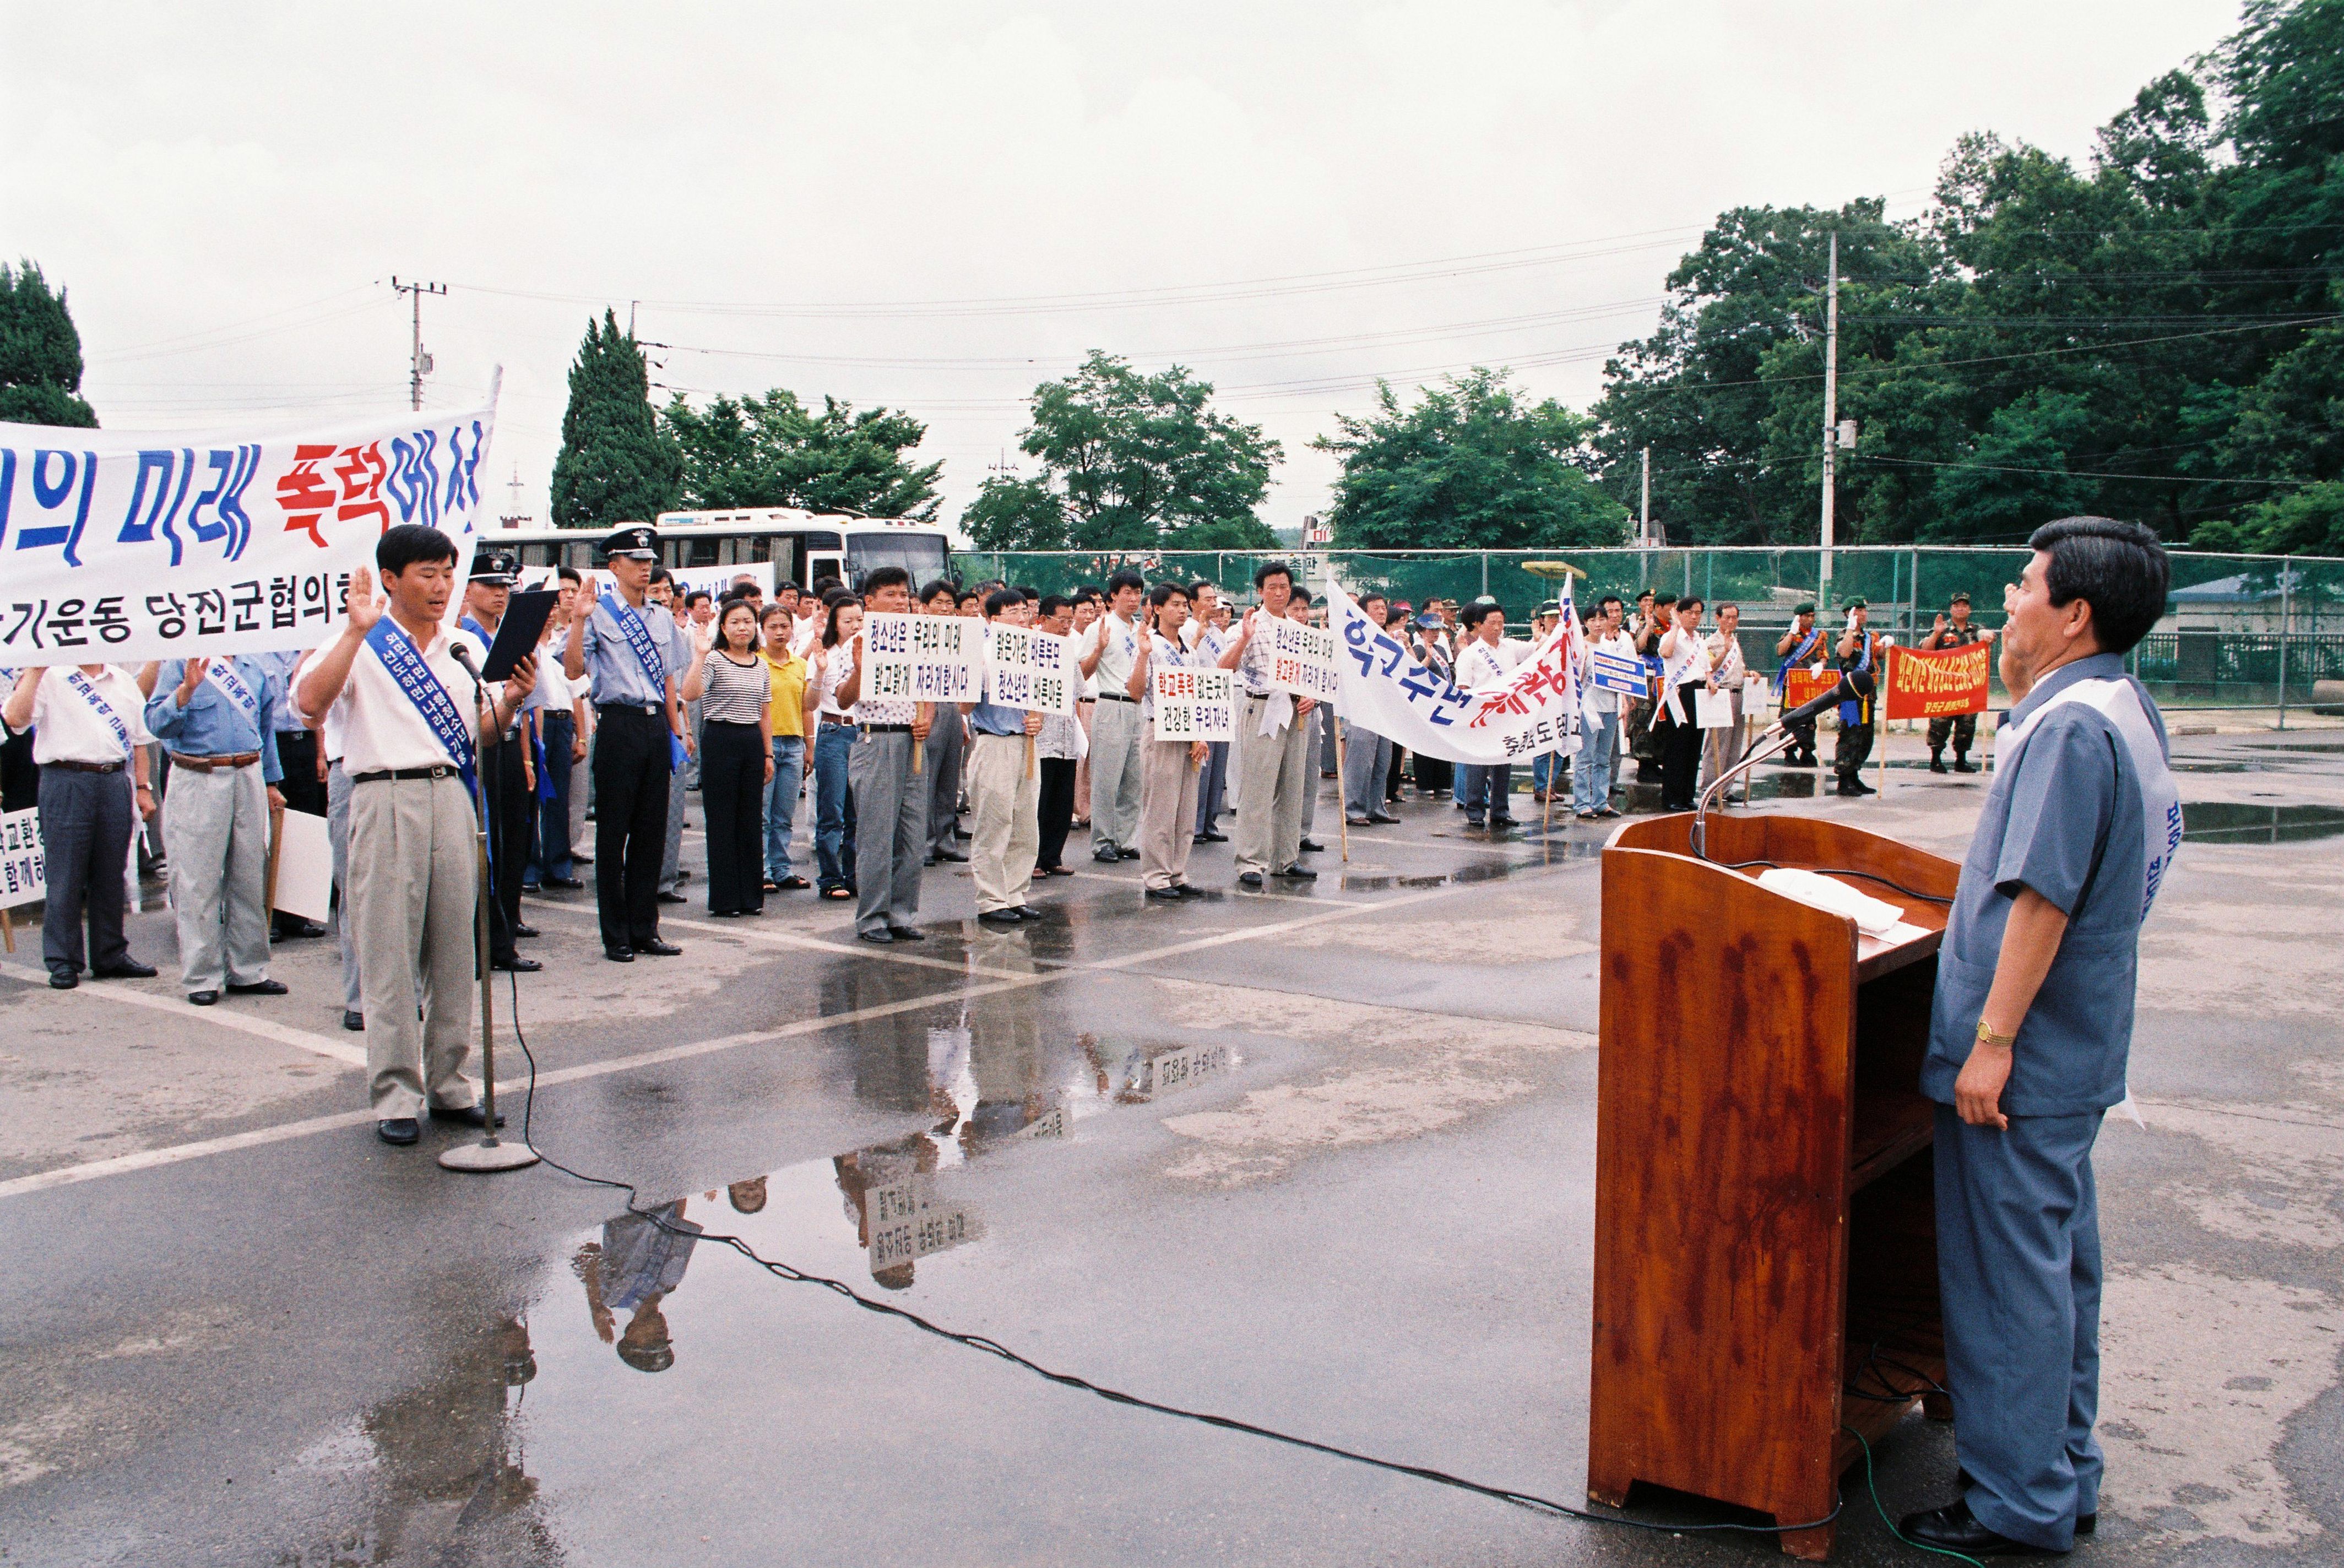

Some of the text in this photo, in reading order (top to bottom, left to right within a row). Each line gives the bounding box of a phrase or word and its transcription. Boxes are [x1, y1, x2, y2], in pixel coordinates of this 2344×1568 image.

[117, 444, 262, 567] 미래
[275, 420, 483, 547] 폭력에서
[0, 599, 131, 648] 기운동
[620, 618, 647, 655] 선도하면
[871, 620, 962, 655] 청소년은 우리의 미래
[997, 630, 1060, 670] 밝은가정 바른부모
[1277, 625, 1334, 662] 청소년은 우리의 미래
[875, 663, 968, 696] 밝고맑게 자라게합시다
[999, 670, 1062, 709] 청소년의 바른마음
[1159, 671, 1194, 700] 학교폭력
[1197, 675, 1230, 701] 없는곳에
[1276, 657, 1300, 686] 밝고맑게
[383, 650, 426, 701] 선도하면
[422, 700, 454, 739] 나라의
[423, 680, 468, 742] 비행청소년
[1164, 706, 1229, 732] 건강한 우리자녀
